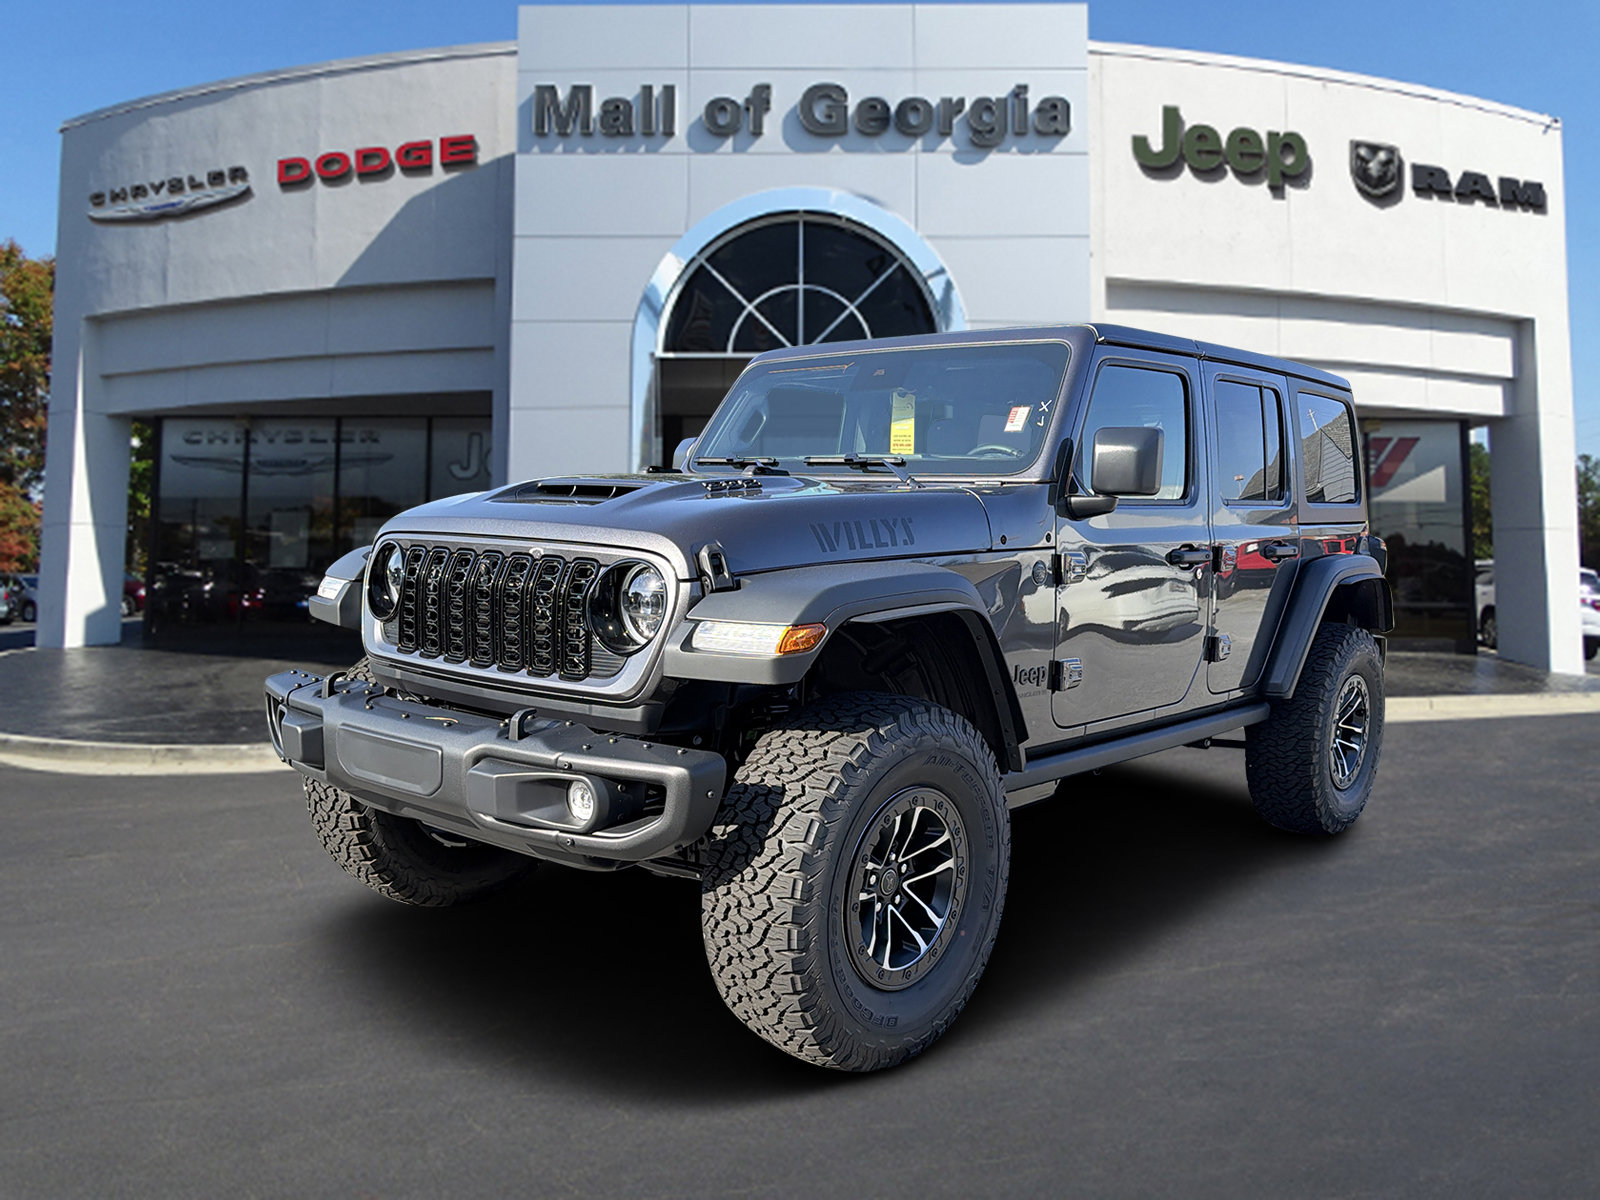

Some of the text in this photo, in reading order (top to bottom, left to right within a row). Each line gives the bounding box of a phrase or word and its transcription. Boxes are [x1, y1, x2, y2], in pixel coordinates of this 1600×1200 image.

[533, 82, 1071, 149] Mall of Georgia
[277, 134, 475, 183] DODGE
[1132, 105, 1308, 187] Jeep
[89, 165, 249, 206] CHRYSLER
[1411, 163, 1544, 213] RAM
[183, 429, 381, 445] CHRYSLER
[808, 517, 915, 553] WILLYS
[1013, 664, 1047, 687] Jeep
